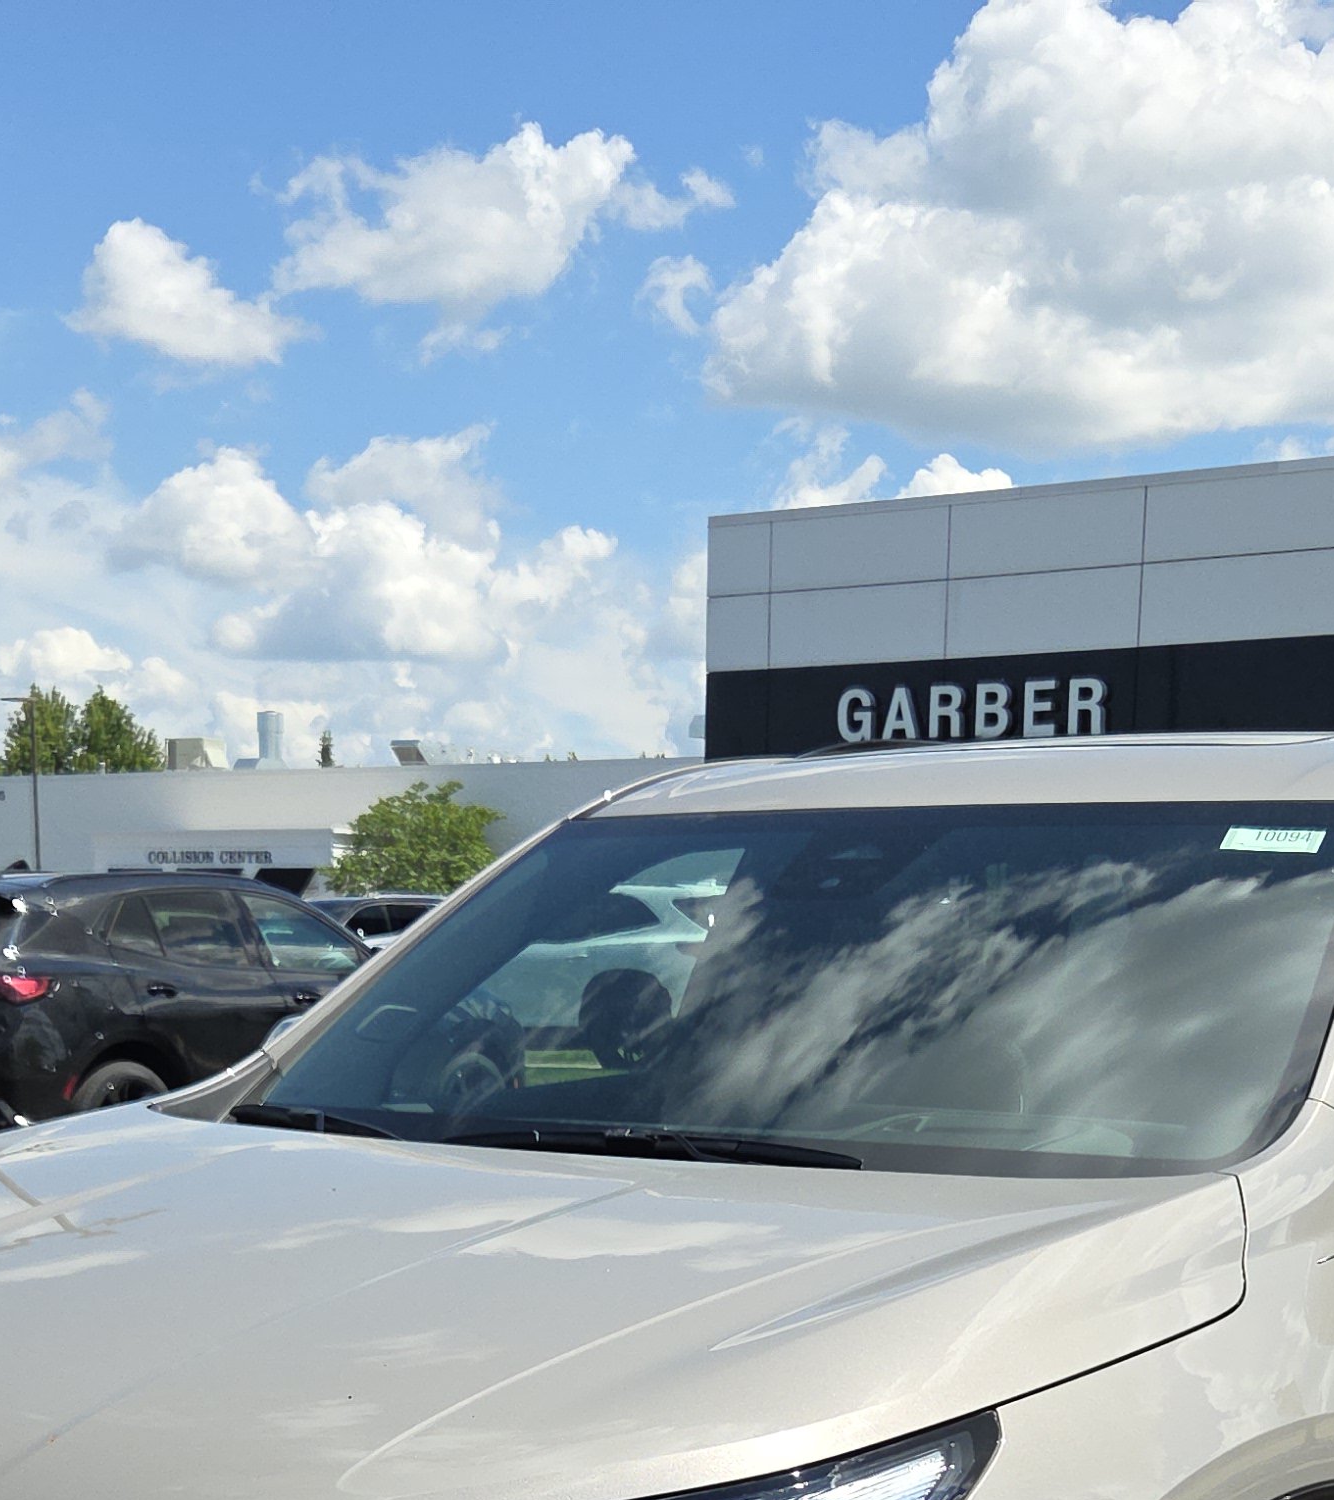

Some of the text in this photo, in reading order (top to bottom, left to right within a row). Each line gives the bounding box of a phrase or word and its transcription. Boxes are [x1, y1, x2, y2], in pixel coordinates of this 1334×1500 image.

[837, 677, 1108, 743] GARBER
[1255, 831, 1313, 843] 10094
[148, 850, 273, 864] COLLISION CENTER
